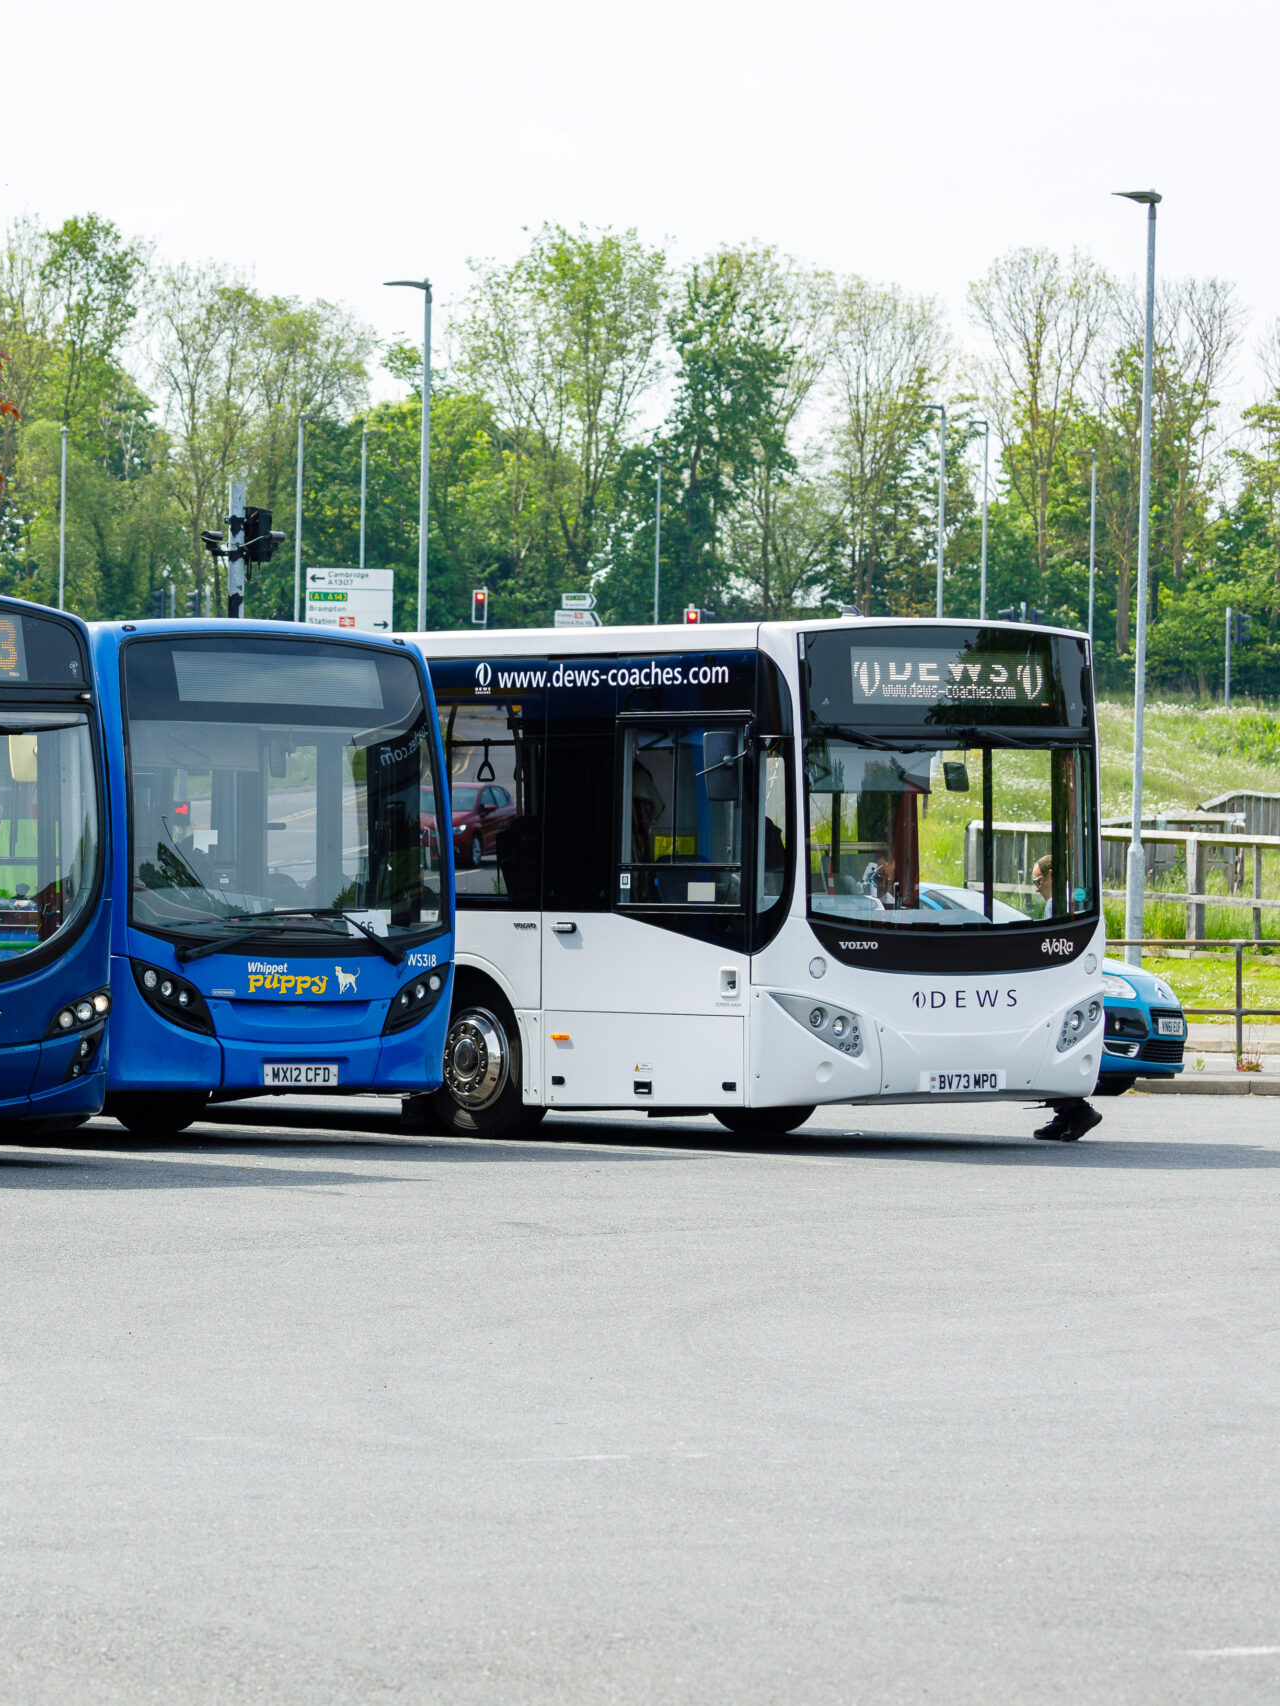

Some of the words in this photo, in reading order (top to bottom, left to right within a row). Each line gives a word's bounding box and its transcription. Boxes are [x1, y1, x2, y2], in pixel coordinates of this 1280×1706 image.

[327, 571, 369, 579] Cambridge
[309, 605, 347, 613] Brampton
[309, 617, 337, 625] Station
[497, 661, 729, 688] www.dews-coaches.com
[882, 682, 1017, 700] www.dews-coaches.com
[839, 941, 878, 950] VOLVO
[407, 953, 437, 967] WS318
[247, 962, 288, 975] Whippet
[247, 973, 329, 995] puppy
[930, 989, 1018, 1009] DEWS
[272, 1067, 302, 1082] MX12
[305, 1067, 330, 1082] CFD
[939, 1074, 970, 1090] BV73
[973, 1073, 997, 1089] MPO
